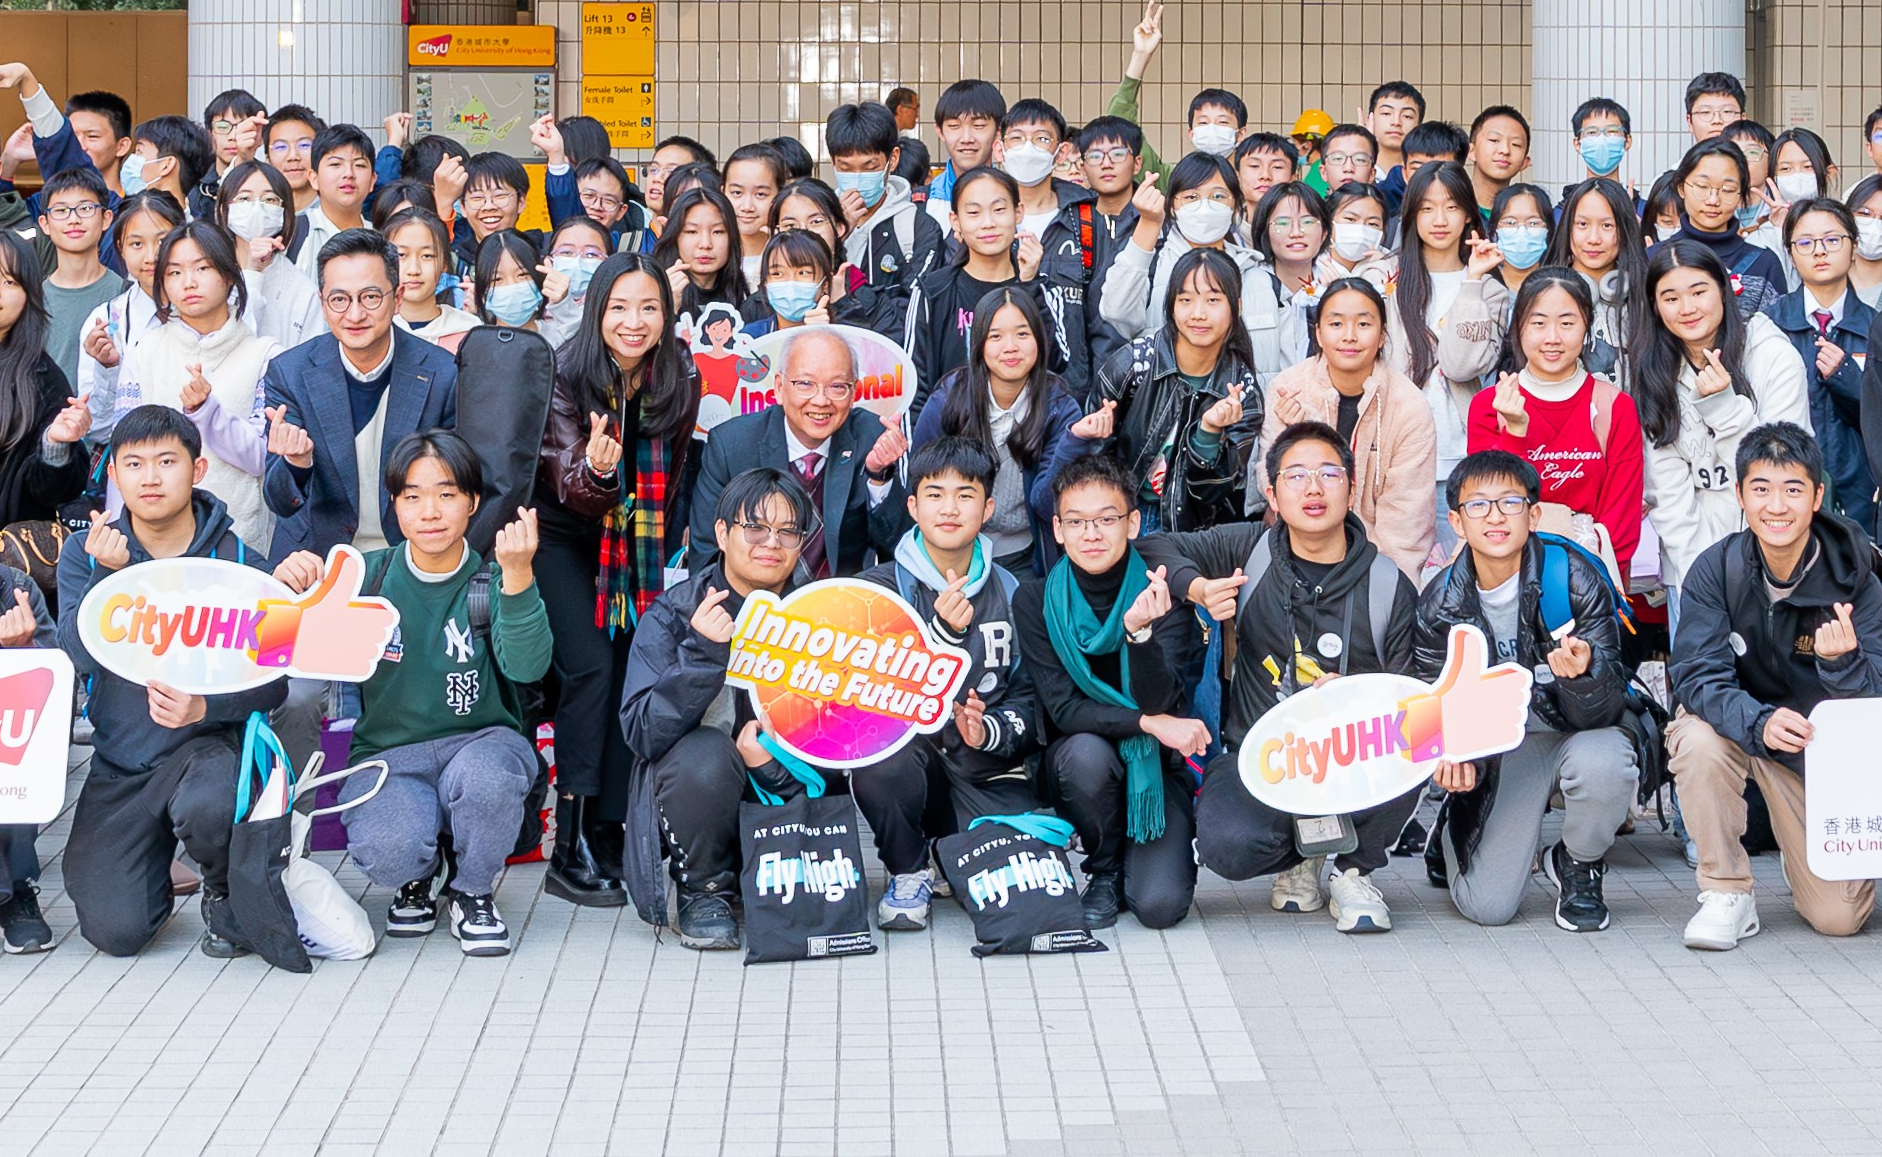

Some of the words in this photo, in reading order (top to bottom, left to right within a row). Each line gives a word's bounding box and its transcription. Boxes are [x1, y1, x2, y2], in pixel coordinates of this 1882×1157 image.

[584, 15, 599, 23] Lift
[603, 15, 613, 23] 13
[585, 26, 612, 35] 升降機
[616, 26, 626, 34] 13
[417, 42, 449, 56] CityU
[456, 38, 510, 46] 香港城市大學
[456, 47, 470, 55] City
[471, 47, 504, 56] University
[506, 46, 514, 54] of
[515, 47, 533, 55] Hong
[533, 47, 551, 55] Kong
[614, 86, 633, 94] Toilet
[1527, 444, 1602, 461] American
[1540, 461, 1585, 492] Eagle
[99, 592, 267, 656] CityUHK
[743, 603, 959, 696] Innovating
[979, 621, 1012, 668] R
[726, 639, 785, 683] into
[789, 659, 840, 696] the
[841, 673, 940, 721] Future
[1259, 710, 1410, 784] CityUHK
[754, 828, 768, 839] AT
[824, 824, 847, 835] CAN
[957, 853, 970, 868] AT
[973, 838, 1011, 857] CITYU,
[1824, 839, 1855, 855] City
[759, 851, 798, 904] Fly
[800, 848, 857, 902] High
[968, 868, 1010, 911] Fly
[1008, 850, 1073, 896] High
